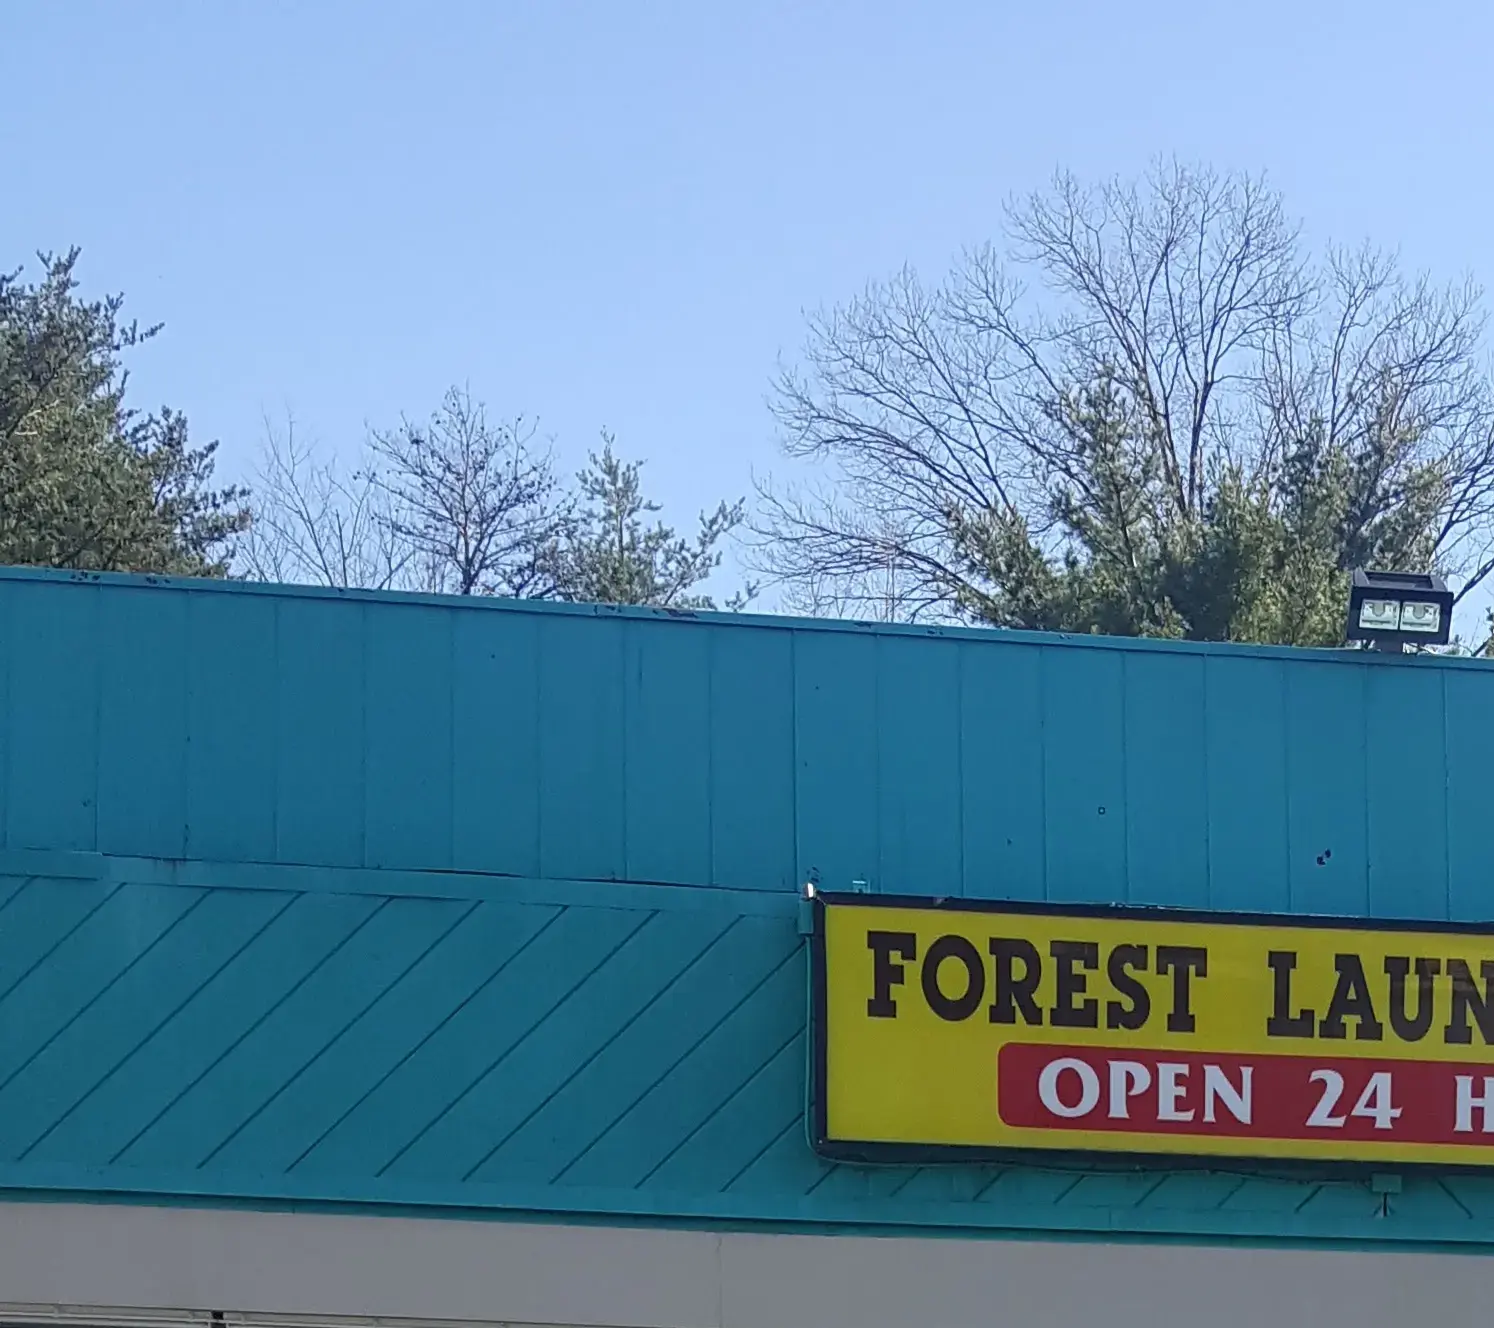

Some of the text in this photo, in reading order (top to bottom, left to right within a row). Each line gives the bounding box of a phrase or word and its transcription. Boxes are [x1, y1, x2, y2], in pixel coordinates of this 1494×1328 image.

[866, 930, 1208, 1033] FOREST
[1038, 1057, 1255, 1128] OPEN
[1304, 1068, 1402, 1130] 24
